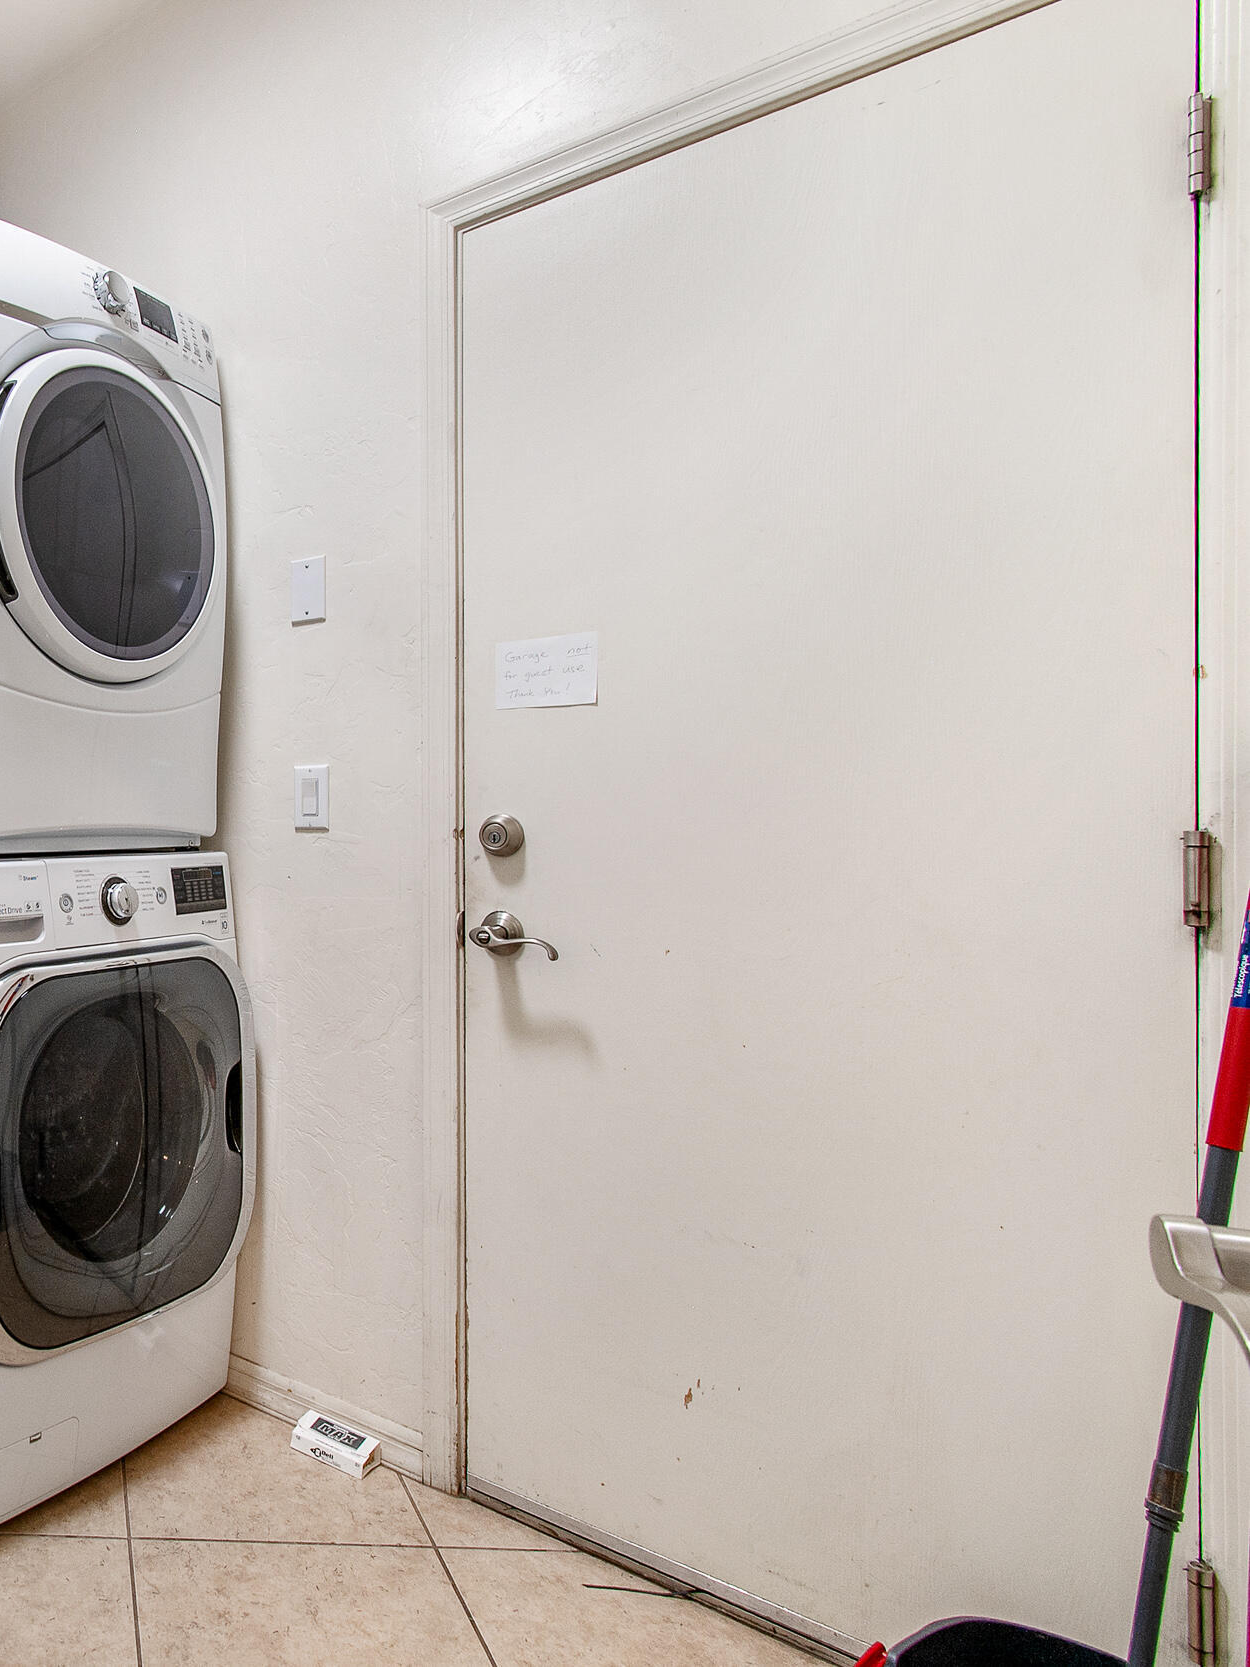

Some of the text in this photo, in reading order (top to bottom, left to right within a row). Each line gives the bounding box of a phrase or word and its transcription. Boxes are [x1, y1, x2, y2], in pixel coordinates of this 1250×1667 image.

[504, 642, 593, 664] Garage not
[504, 664, 585, 682] for guest use
[7, 906, 23, 914] Drive
[318, 1422, 355, 1444] MAX
